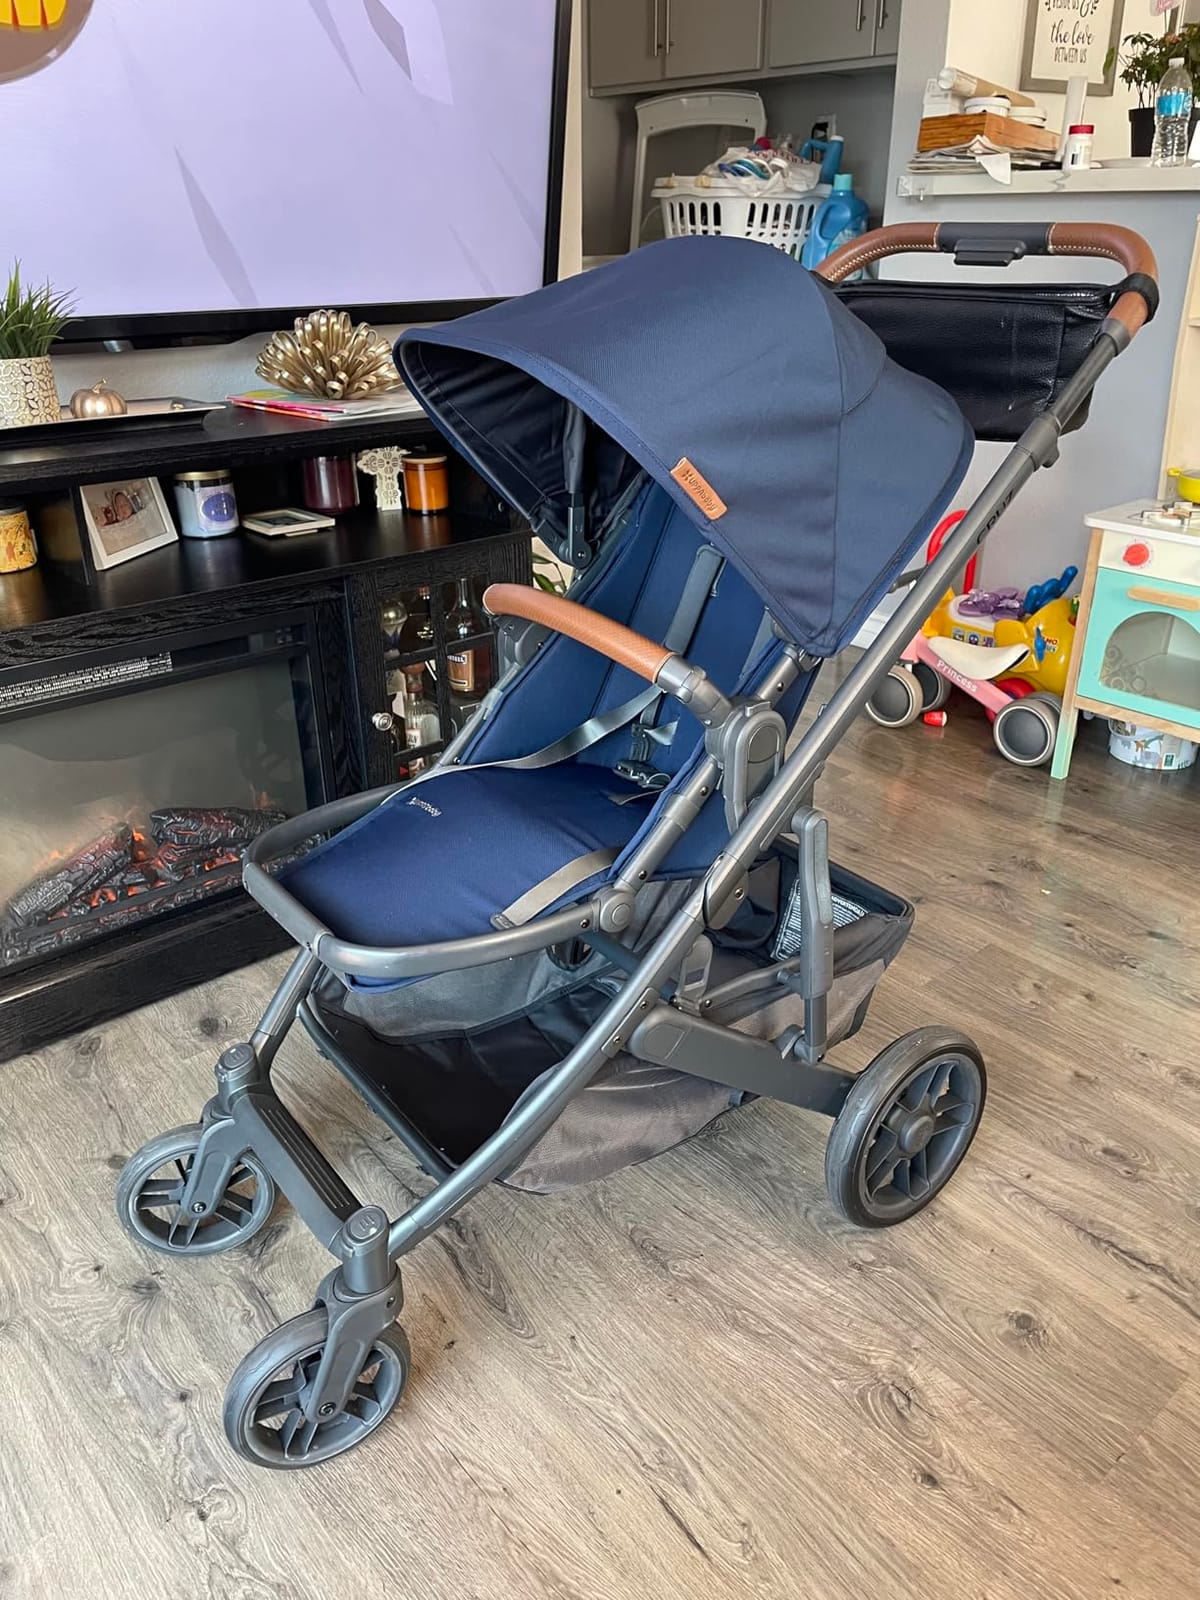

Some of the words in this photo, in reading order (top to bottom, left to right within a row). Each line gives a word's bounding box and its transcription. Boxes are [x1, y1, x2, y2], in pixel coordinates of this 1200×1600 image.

[1050, 19, 1070, 44] the
[1072, 20, 1094, 45] love
[1054, 46, 1078, 63] BETWEEN
[1079, 48, 1088, 63] US
[936, 659, 978, 693] Princess
